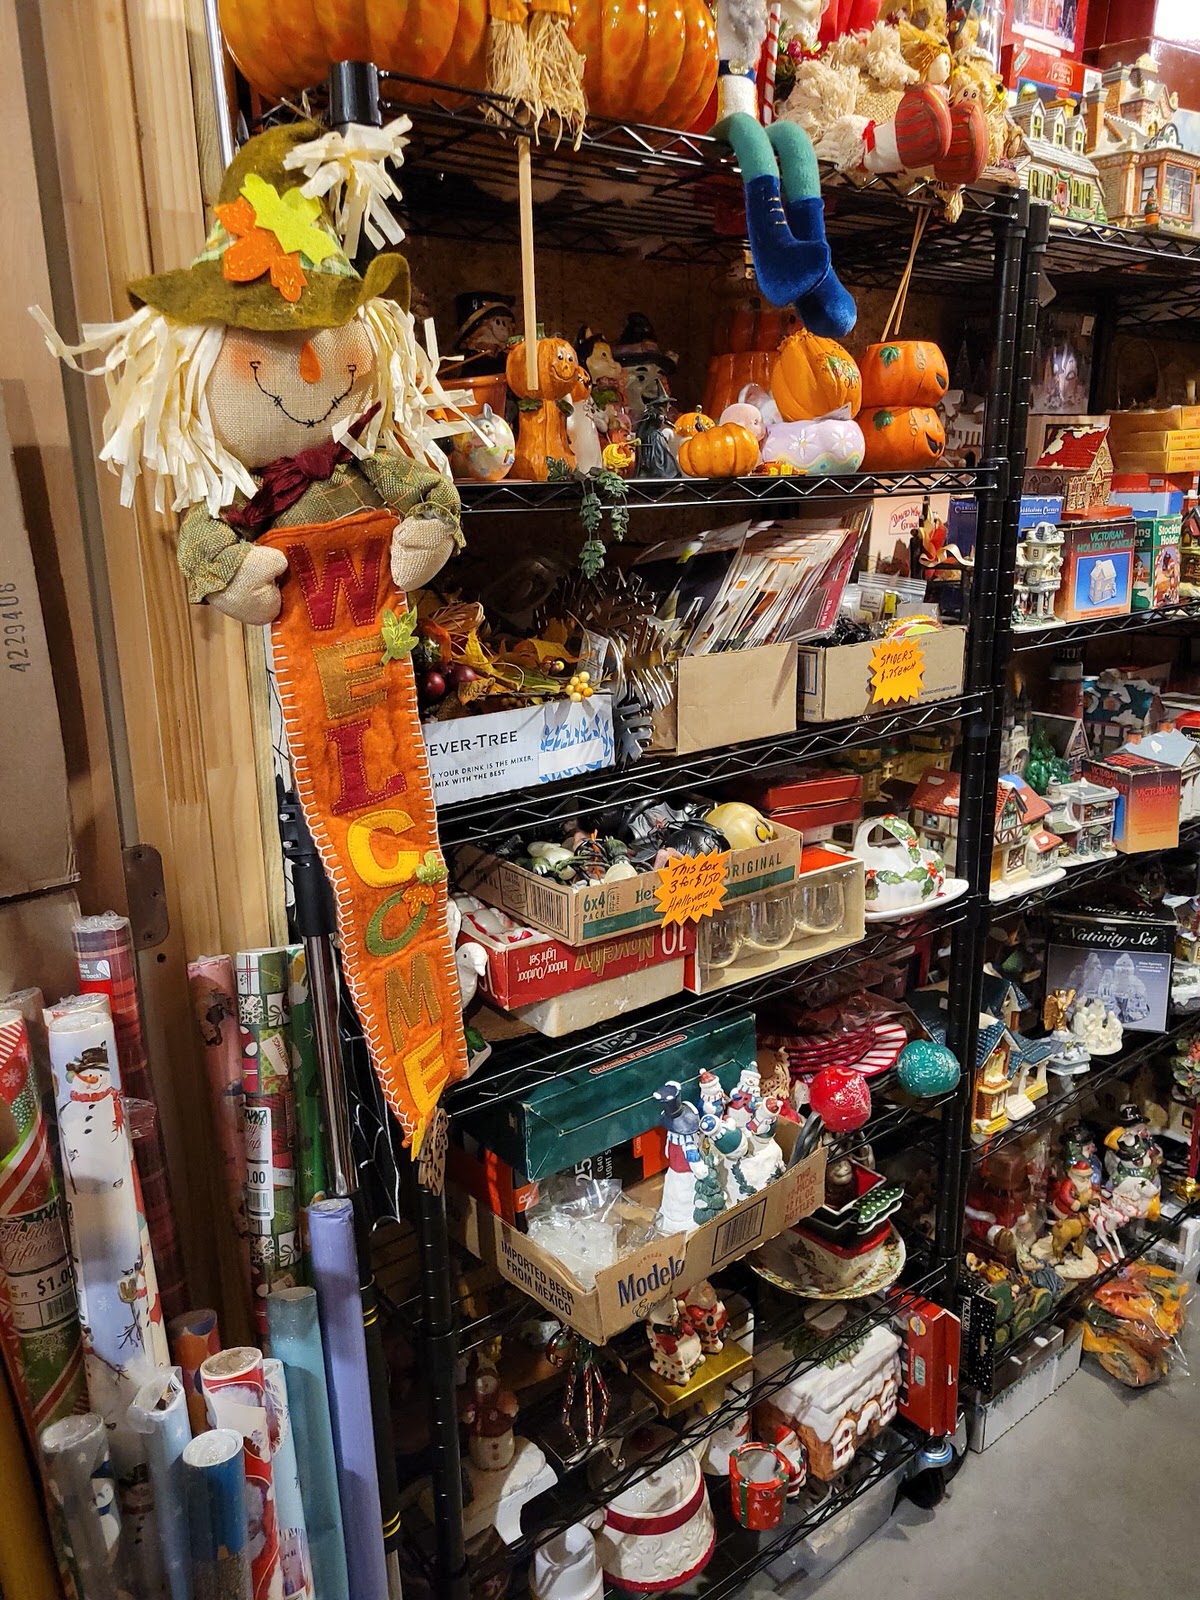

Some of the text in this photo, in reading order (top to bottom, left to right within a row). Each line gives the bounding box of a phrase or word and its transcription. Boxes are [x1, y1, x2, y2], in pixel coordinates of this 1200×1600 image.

[1090, 530, 1125, 541] VICTORIAN
[1160, 534, 1180, 546] Holder
[1076, 541, 1108, 553] HOLIDAY
[879, 649, 914, 668] SPIDERS
[438, 768, 460, 778] YOUR
[461, 765, 485, 774] DRINK
[486, 762, 494, 770] IS
[495, 759, 509, 768] THE
[510, 755, 534, 766] MIXER,
[434, 769, 506, 788] MIX WITH THE BEST
[1136, 784, 1178, 797] VICTORIAN
[286, 537, 450, 1117] WELCOME
[668, 881, 677, 894] 3
[679, 874, 694, 888] for
[583, 907, 606, 922] PACK
[660, 923, 687, 956] 10
[1061, 926, 1159, 948] Nativity Set
[528, 947, 557, 967] Light Set
[574, 928, 657, 977] Novelty
[517, 959, 568, 984] Indoor/Outdoor
[574, 1157, 593, 1187] 25
[637, 1252, 663, 1268] CERVEZA
[500, 1240, 575, 1305] IMPORTED BEER
[617, 1255, 685, 1309] Modelo
[506, 1258, 573, 1316] FROM MEXICO
